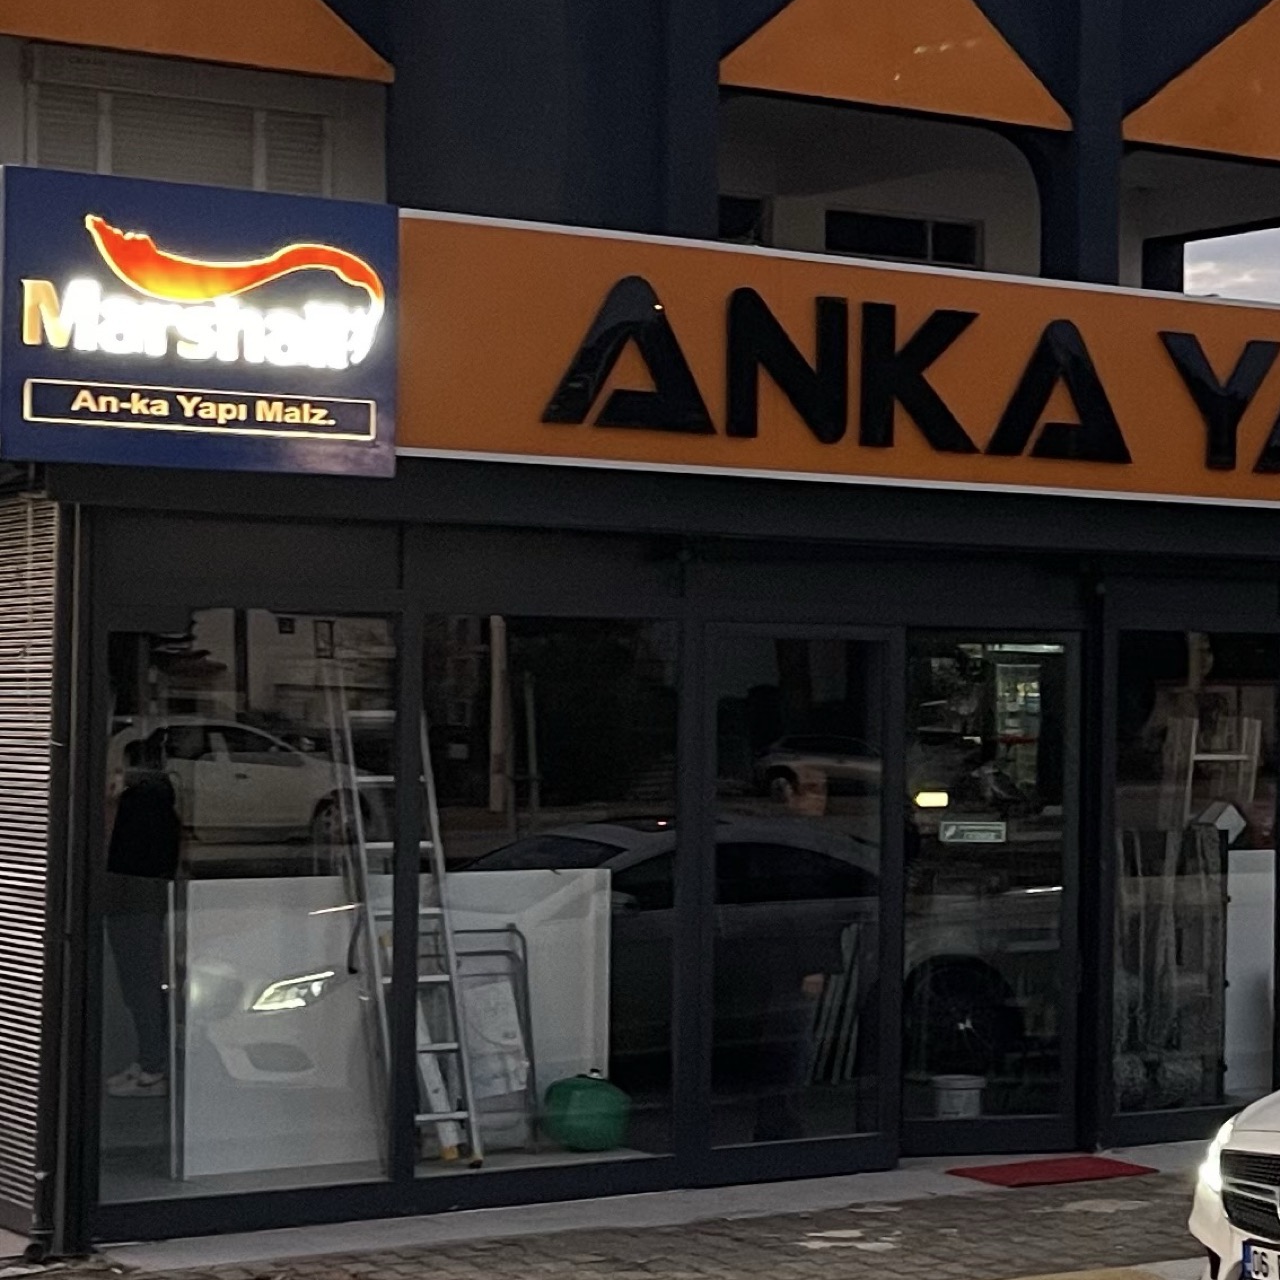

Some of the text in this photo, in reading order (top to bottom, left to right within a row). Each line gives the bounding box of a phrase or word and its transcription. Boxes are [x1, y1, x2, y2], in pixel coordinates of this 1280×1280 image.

[71, 389, 170, 417] An-ka
[176, 394, 248, 425] Yapı
[541, 275, 1132, 465] ANKA
